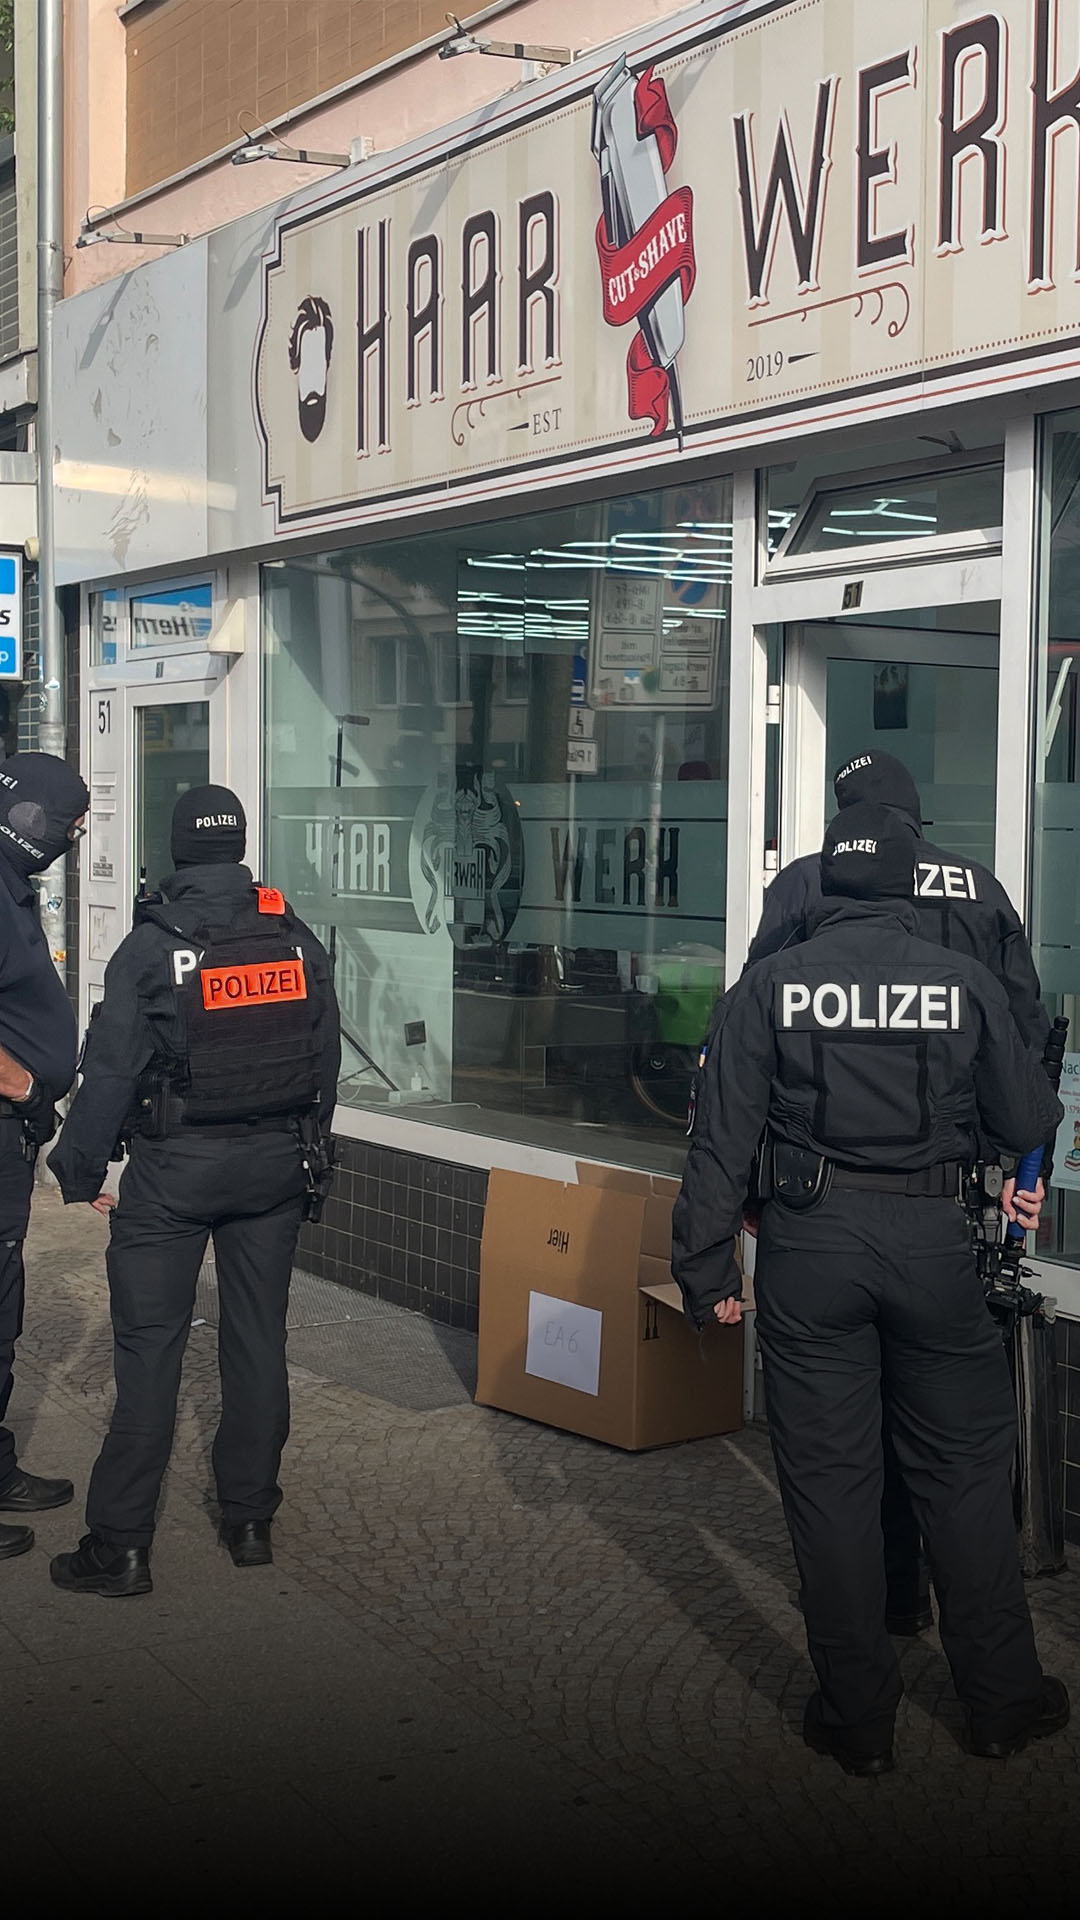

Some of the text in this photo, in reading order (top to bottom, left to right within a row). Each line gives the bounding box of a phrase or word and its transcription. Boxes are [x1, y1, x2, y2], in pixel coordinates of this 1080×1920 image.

[356, 189, 562, 460] HAAR
[532, 350, 784, 436] EST 2019
[843, 581, 861, 609] 51
[98, 700, 111, 735] 51
[196, 814, 238, 829] POLIZEI
[0, 823, 45, 860] OLIZEI
[549, 825, 681, 908] WERK
[209, 968, 300, 1001] POLIZEI
[782, 982, 960, 1030] POLIZEI
[547, 1228, 570, 1254] Hier
